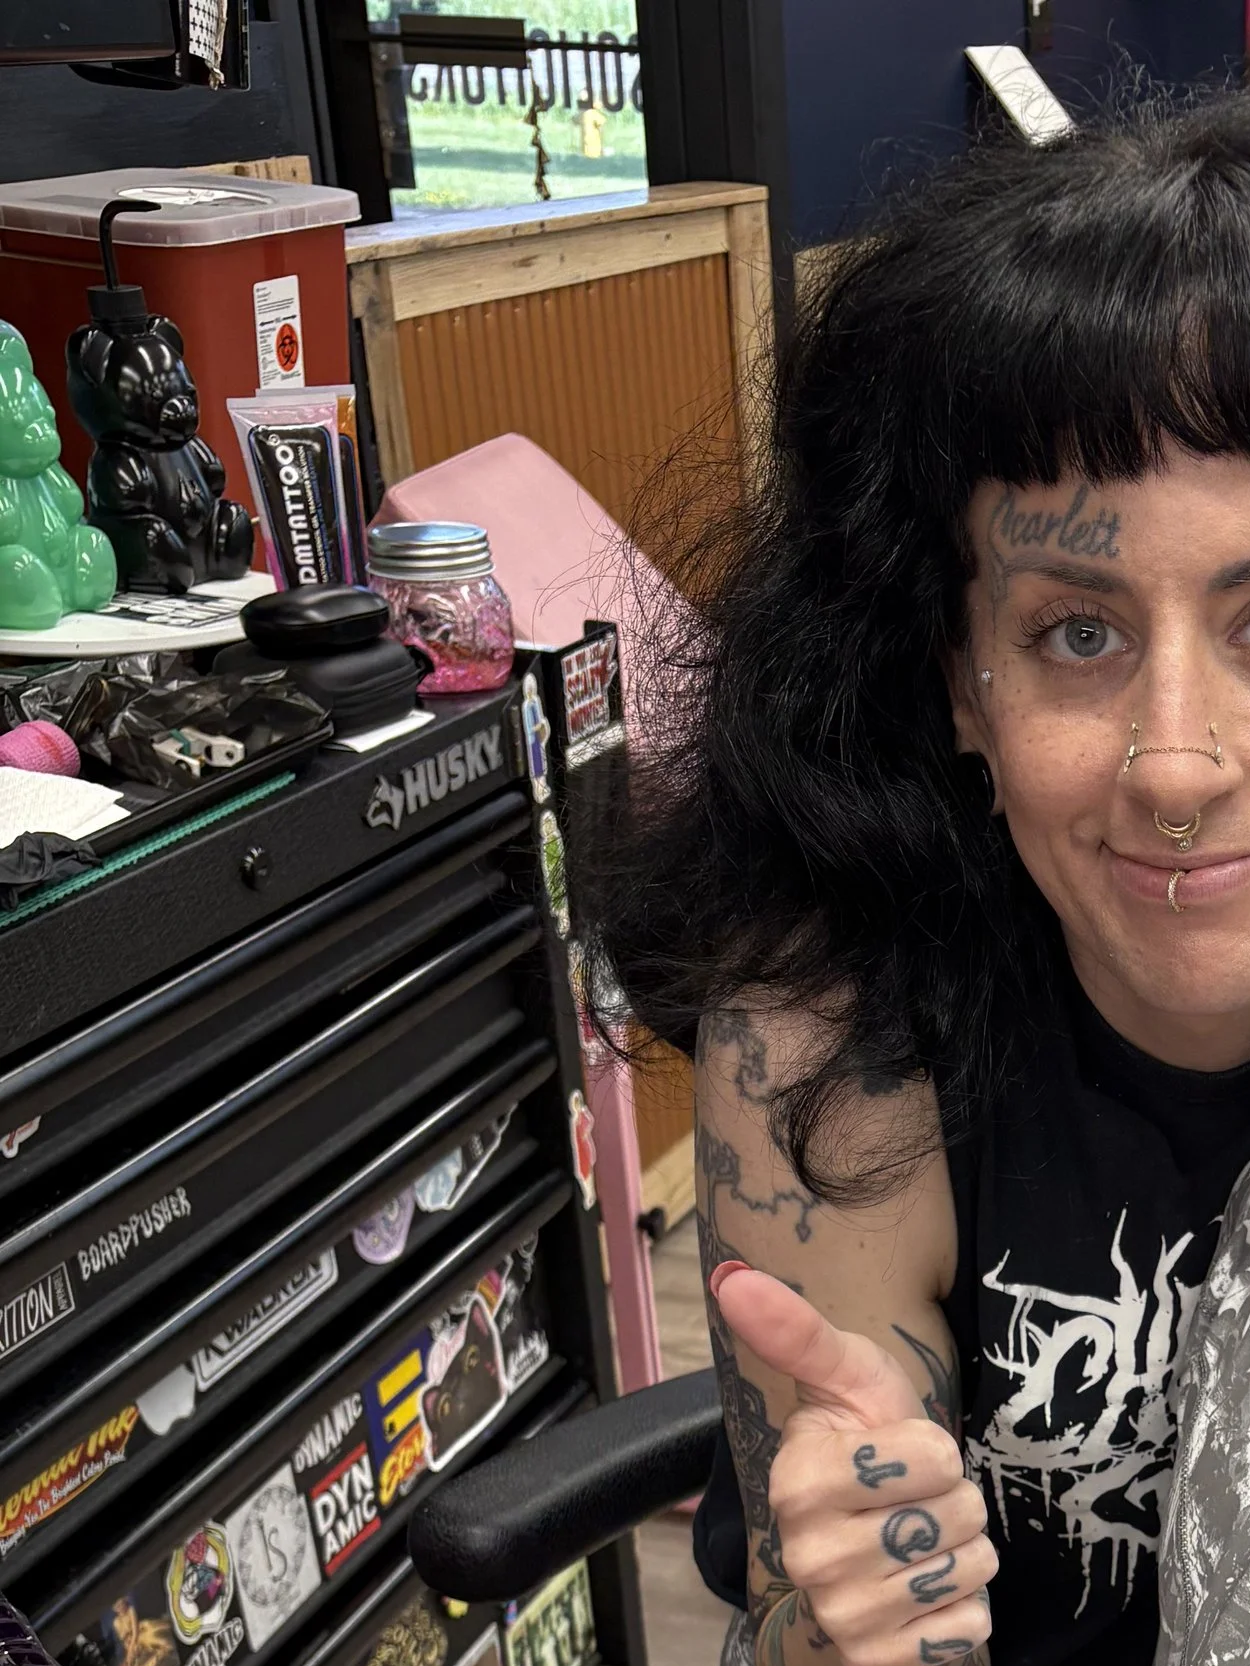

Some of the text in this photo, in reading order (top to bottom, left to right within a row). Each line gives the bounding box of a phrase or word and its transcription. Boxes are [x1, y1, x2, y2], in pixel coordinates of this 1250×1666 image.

[401, 724, 504, 815] HUSKY
[77, 1186, 192, 1282] BOARDPUSHER
[293, 1392, 363, 1474] DYNAMIC
[312, 1453, 375, 1537] DYN
[324, 1491, 377, 1563] AMIC
